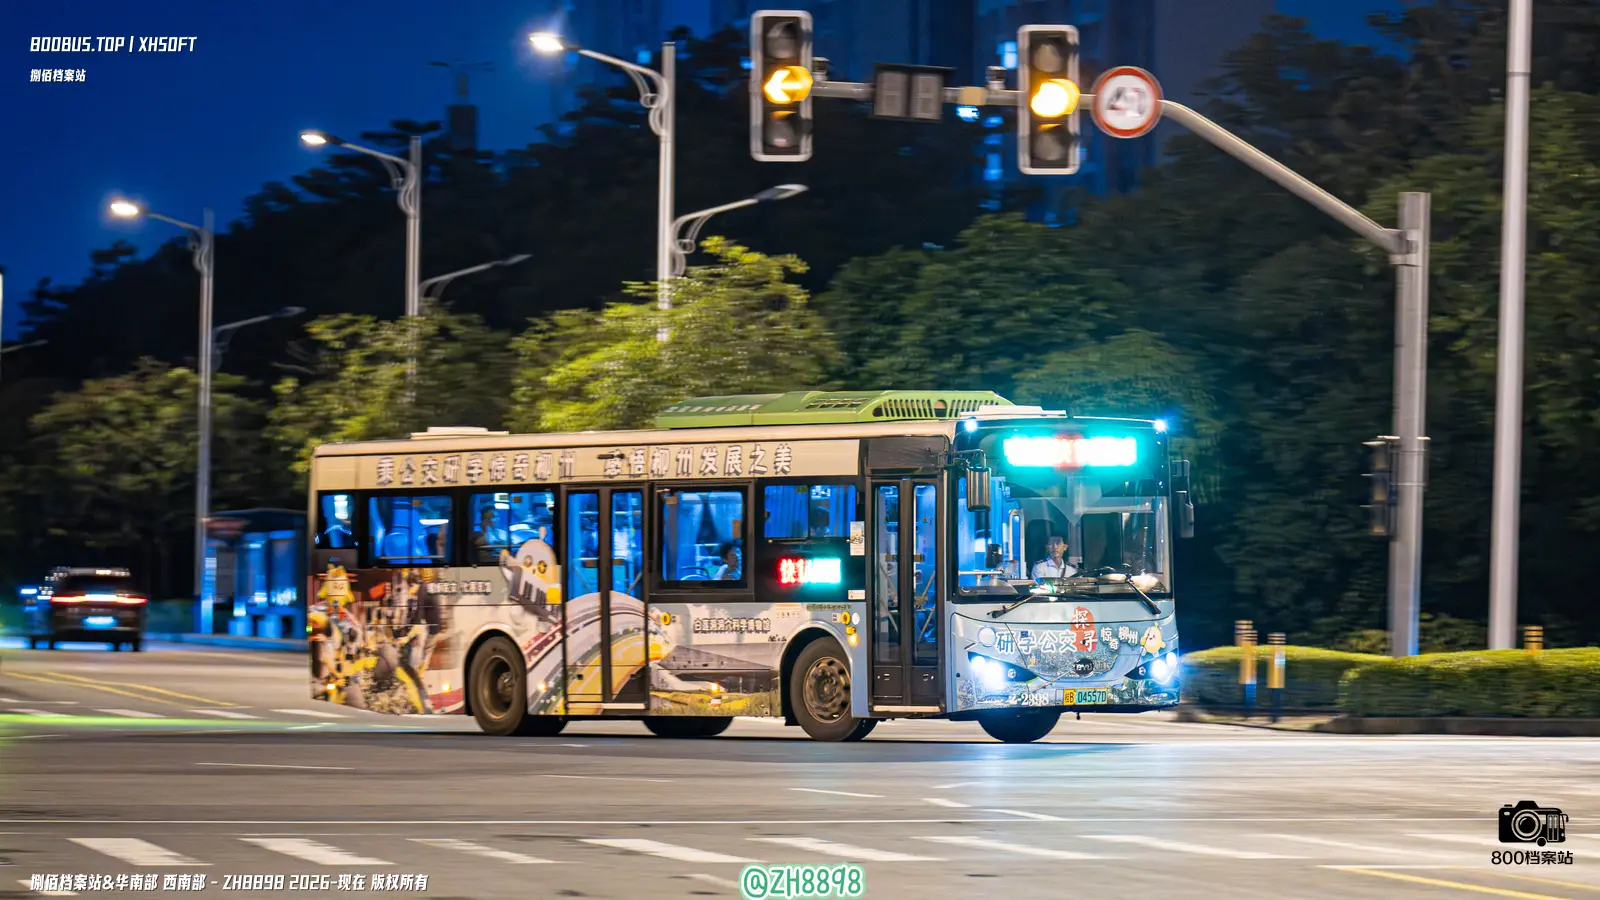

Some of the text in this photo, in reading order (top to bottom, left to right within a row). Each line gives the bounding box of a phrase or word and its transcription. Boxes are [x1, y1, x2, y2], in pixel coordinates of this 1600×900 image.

[603, 443, 793, 479] 感悟柳州发展之美
